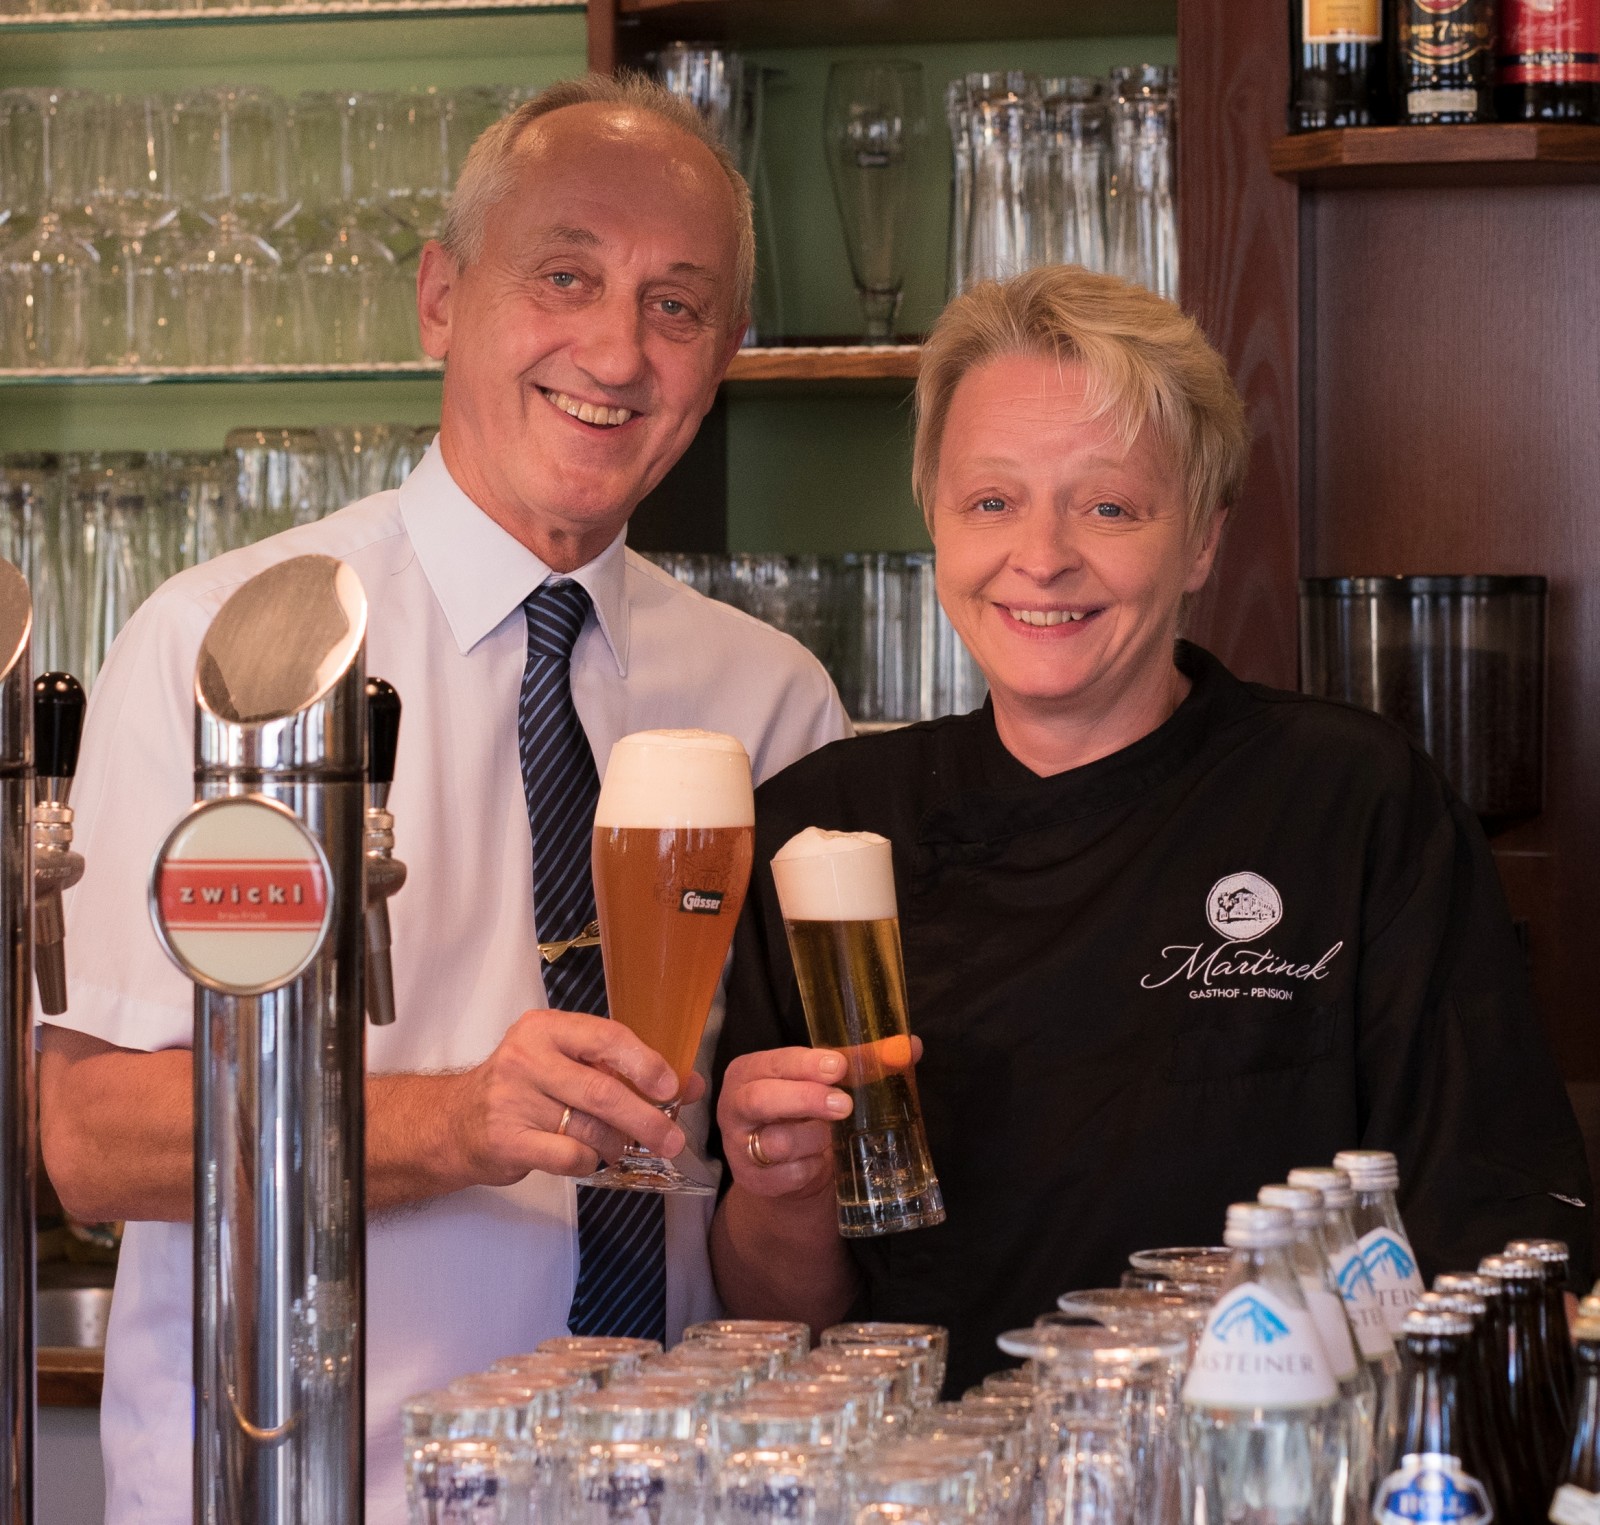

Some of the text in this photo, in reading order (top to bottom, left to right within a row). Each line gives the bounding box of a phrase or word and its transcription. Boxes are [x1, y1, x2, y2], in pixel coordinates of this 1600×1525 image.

[179, 884, 303, 903] zwickl
[682, 891, 721, 911] Gösser
[1140, 940, 1343, 989] Martinek
[1188, 988, 1240, 1000] GASTHOF
[1250, 987, 1294, 1001] PENSION
